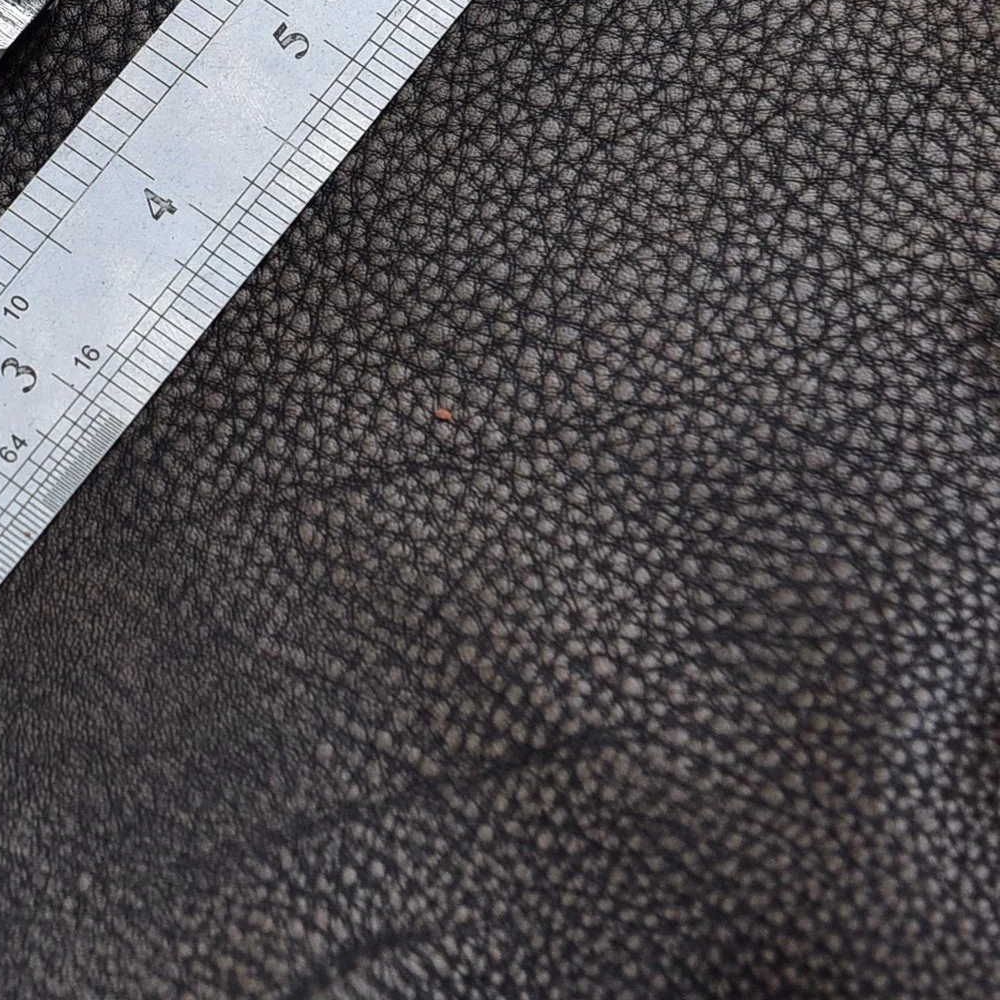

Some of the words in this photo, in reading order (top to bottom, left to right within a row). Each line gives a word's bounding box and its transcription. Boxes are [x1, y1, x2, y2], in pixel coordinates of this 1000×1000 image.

[272, 22, 310, 60] 5
[144, 188, 178, 221] 4
[3, 295, 30, 320] 10
[74, 344, 101, 371] 16
[0, 357, 37, 394] 3
[0, 433, 28, 463] 64
